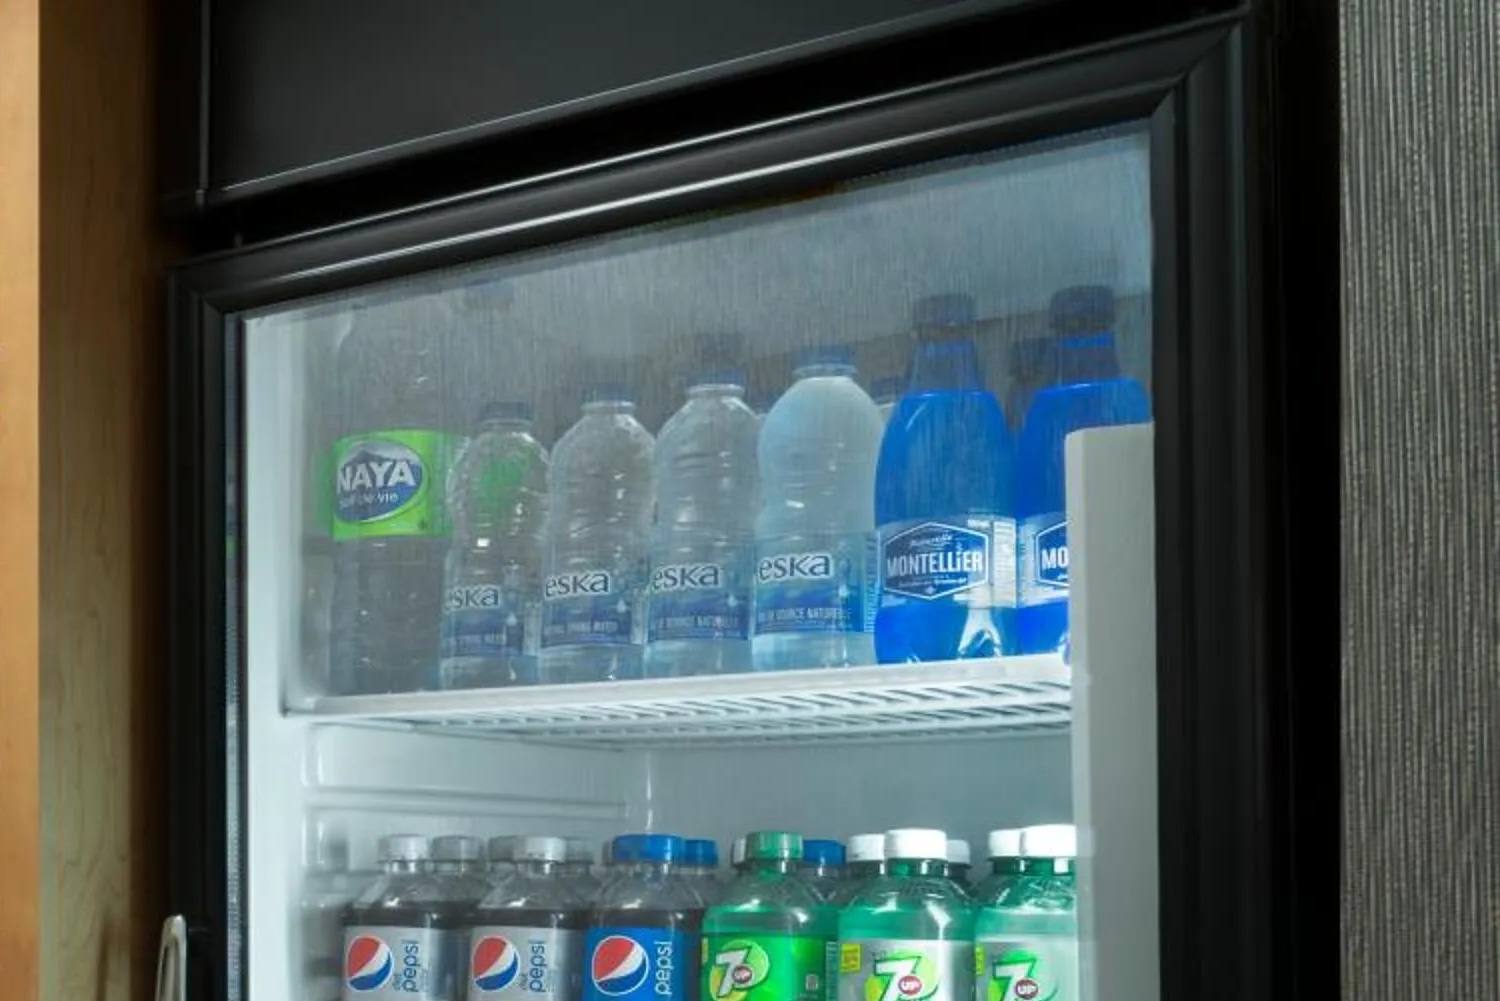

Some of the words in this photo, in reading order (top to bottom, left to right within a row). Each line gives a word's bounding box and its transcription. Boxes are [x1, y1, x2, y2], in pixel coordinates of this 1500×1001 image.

[337, 460, 417, 493] NAYA
[758, 553, 832, 582] eska
[1041, 547, 1069, 570] MO
[544, 571, 611, 599] eska
[651, 564, 721, 590] eska
[401, 938, 420, 994] pepsi
[528, 938, 547, 994] pepsi
[653, 940, 674, 996] pepsi
